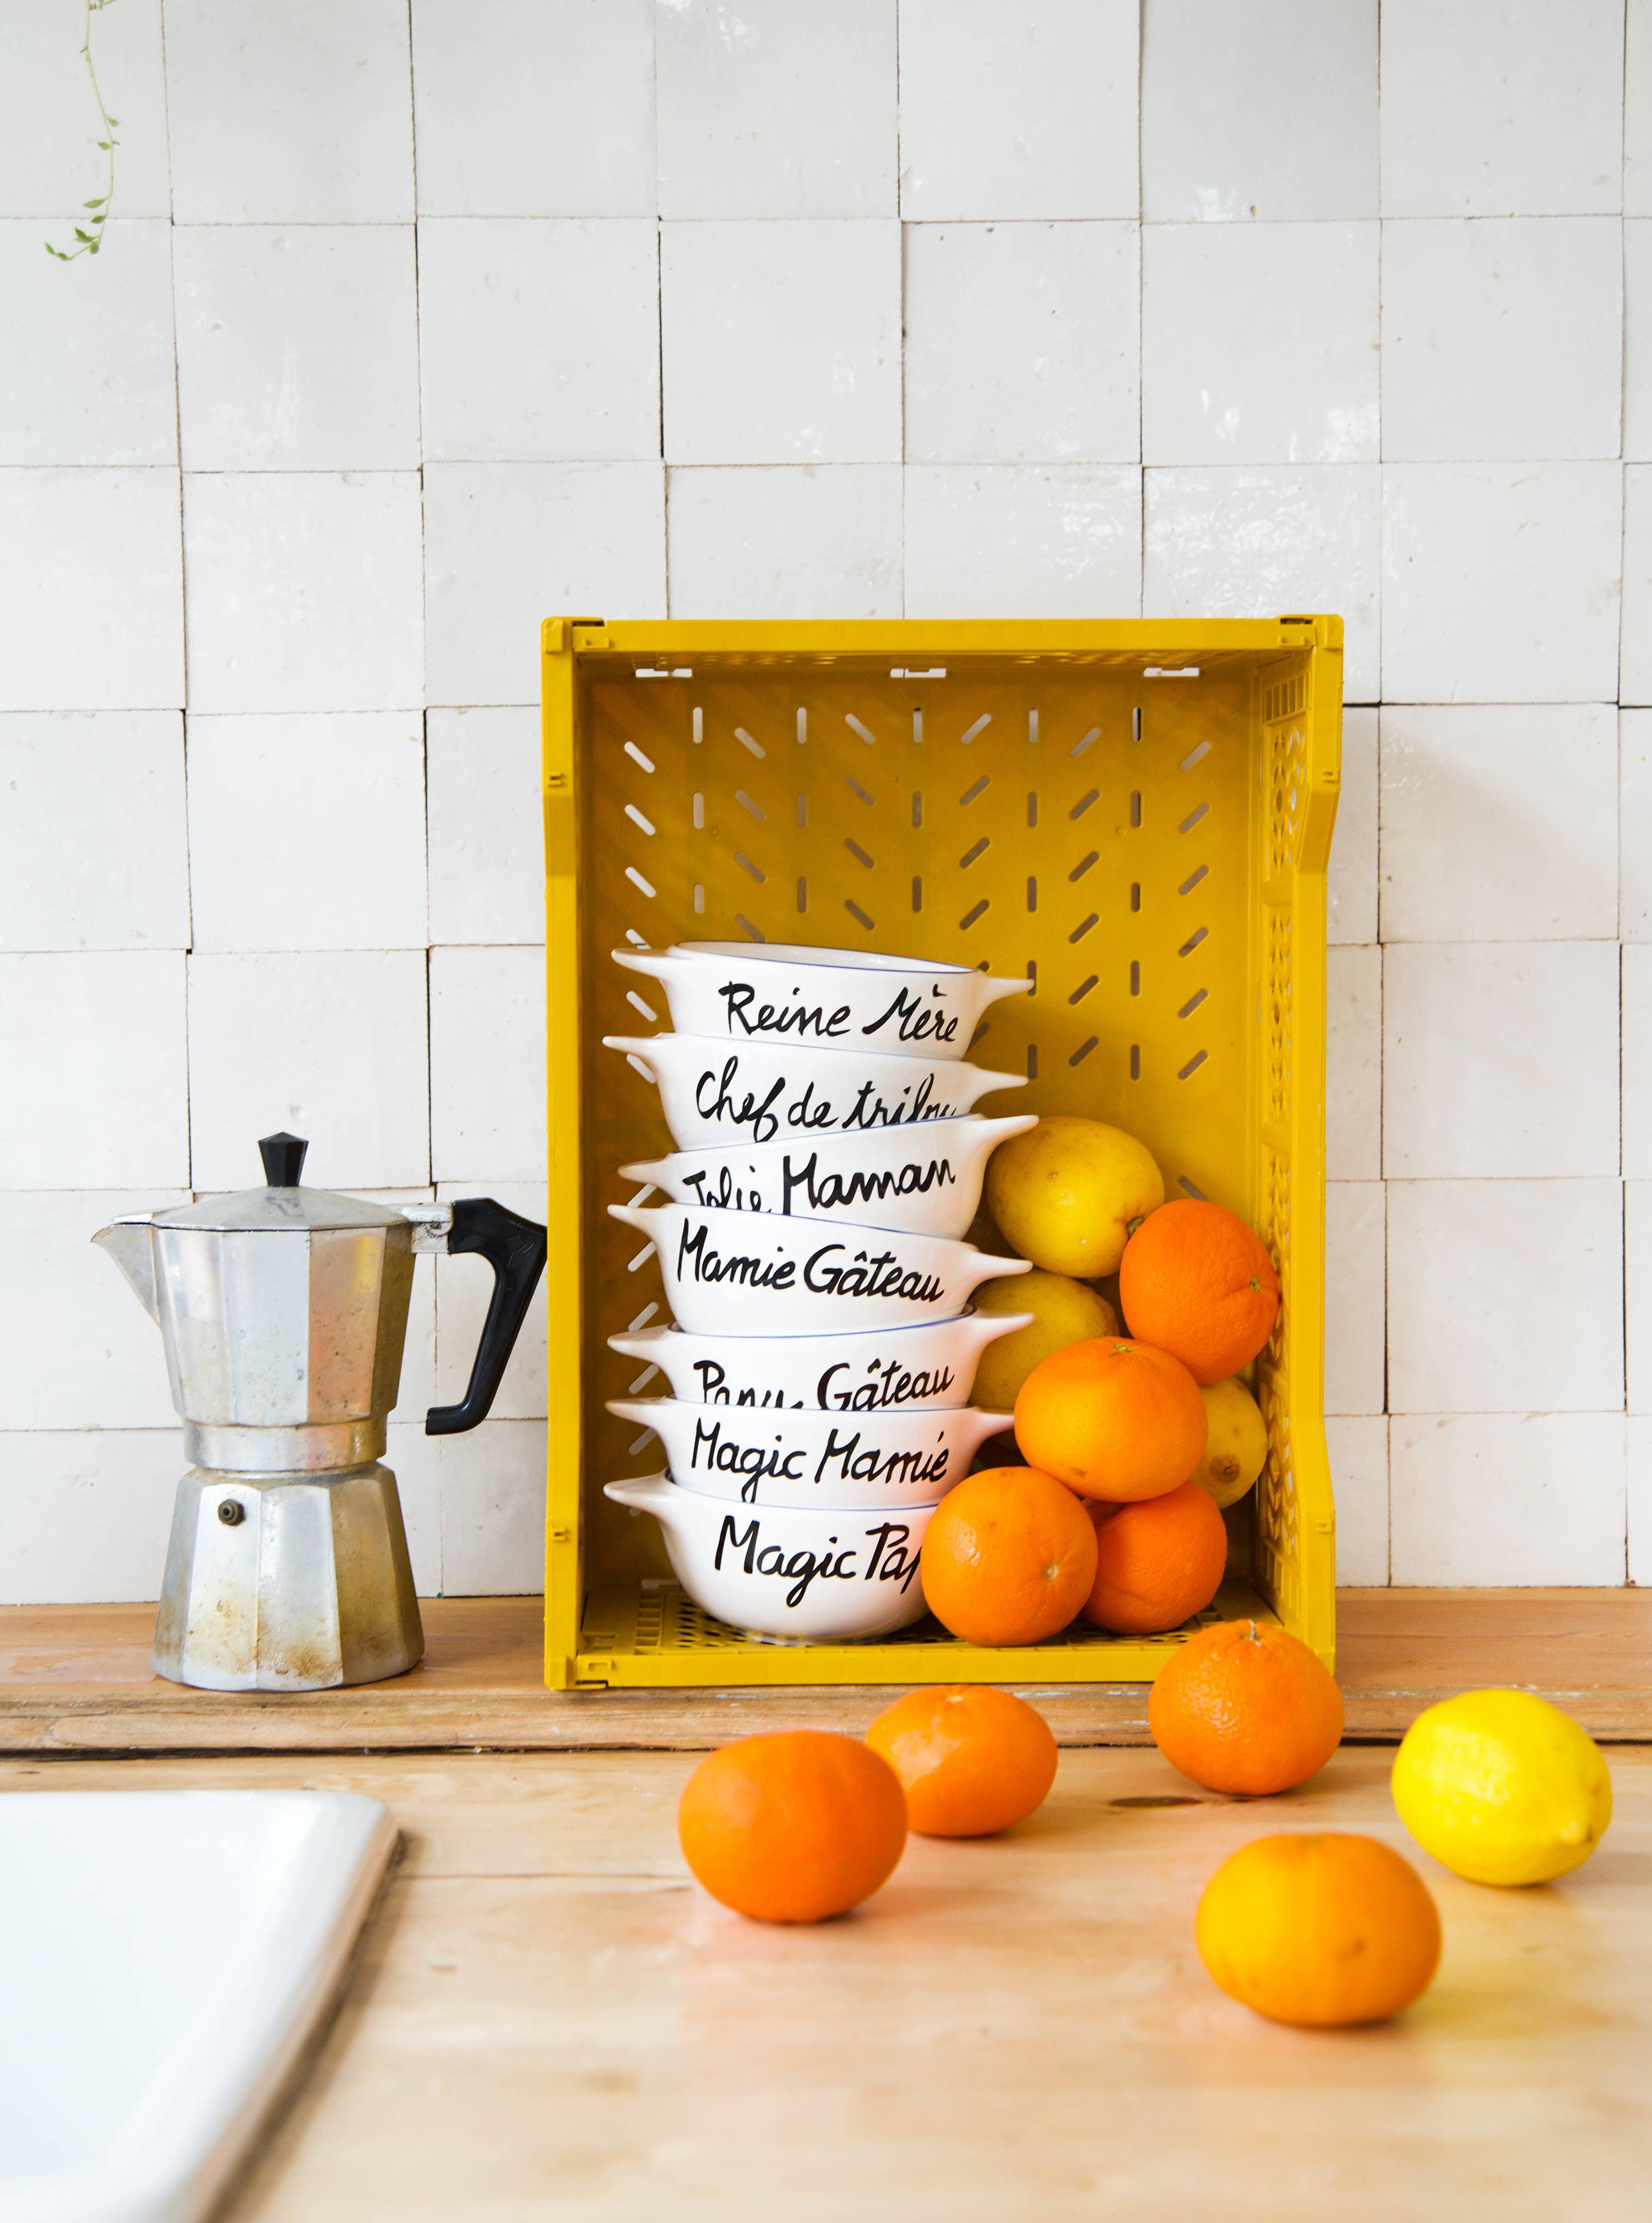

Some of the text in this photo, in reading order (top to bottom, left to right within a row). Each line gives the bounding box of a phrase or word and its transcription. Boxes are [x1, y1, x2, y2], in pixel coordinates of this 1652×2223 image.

[718, 981, 959, 1042] Reine Mère
[696, 1056, 786, 1143] Chef
[787, 1081, 839, 1128] de
[782, 1153, 955, 1216] Maman
[677, 1218, 944, 1303] Mamie Gâteau
[817, 1357, 955, 1412] Gâteau
[691, 1417, 807, 1503] Magic
[715, 1515, 857, 1608] Magic
